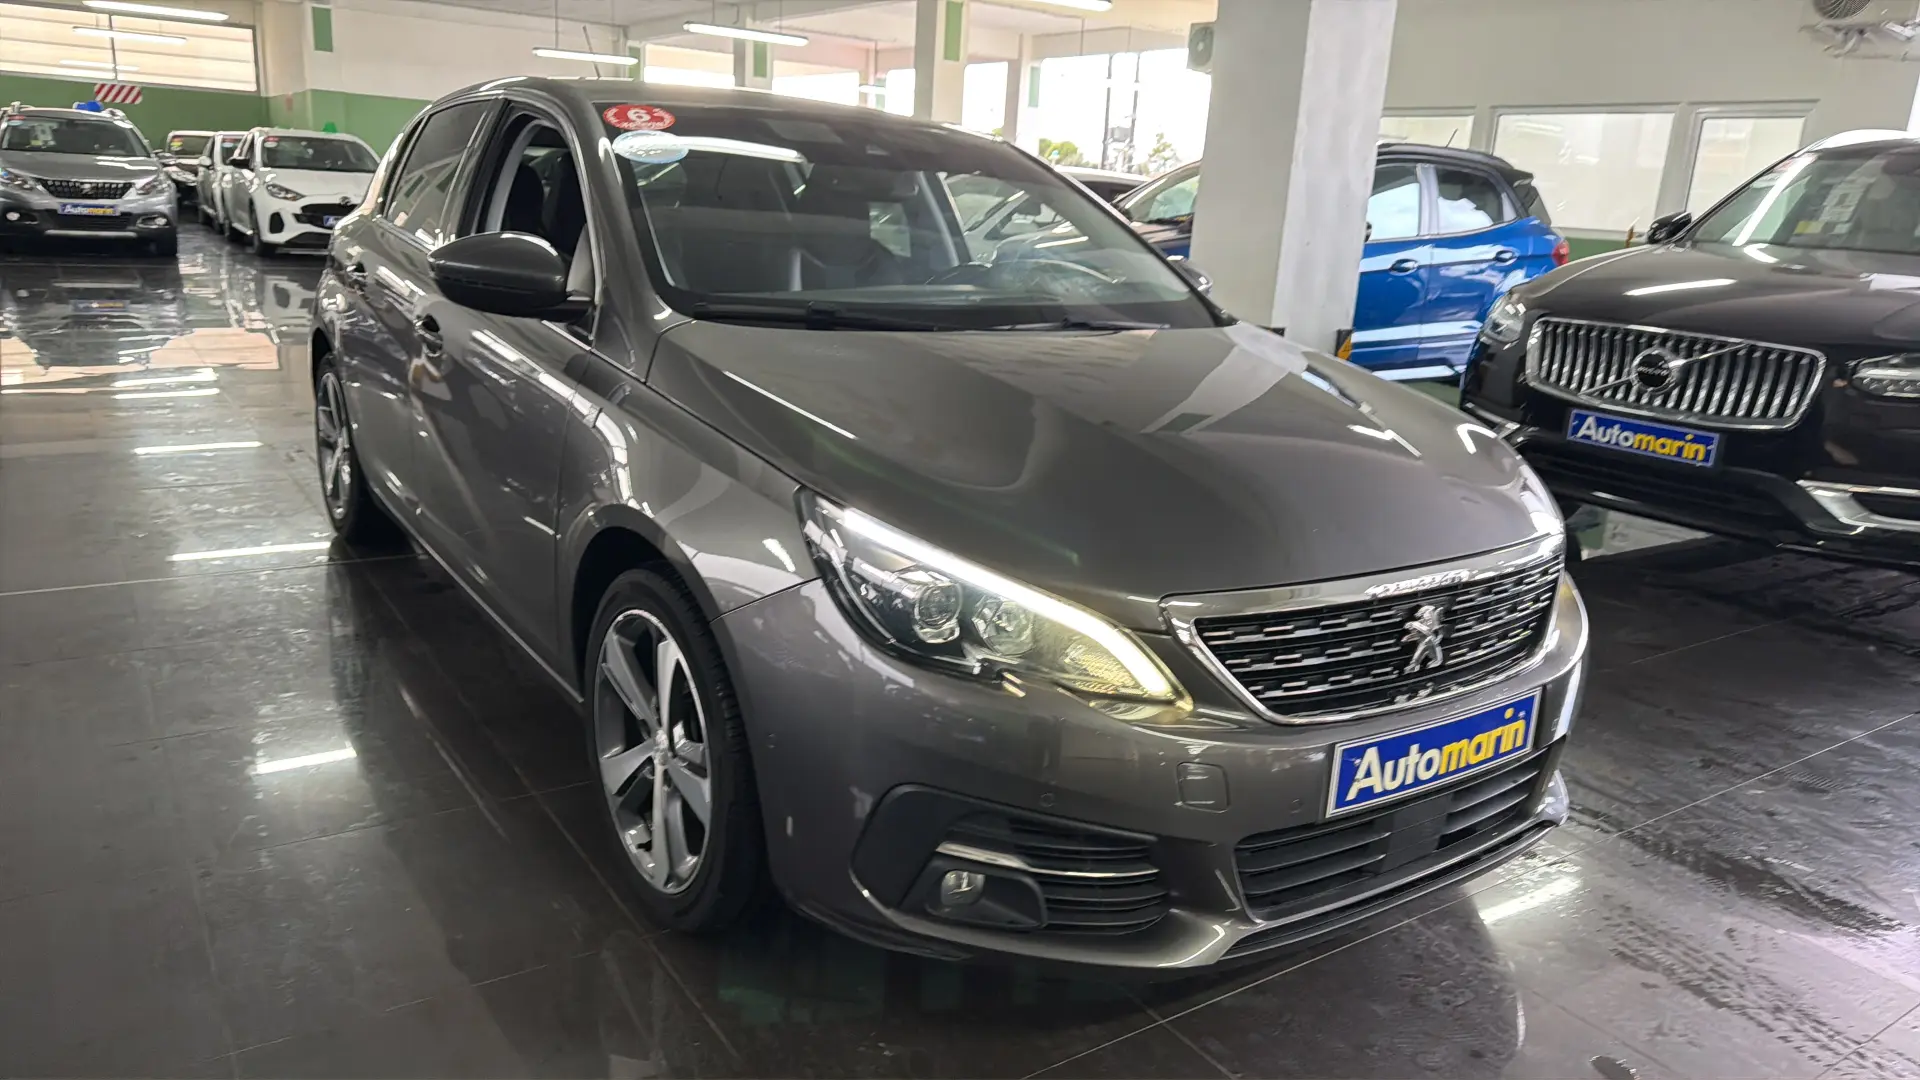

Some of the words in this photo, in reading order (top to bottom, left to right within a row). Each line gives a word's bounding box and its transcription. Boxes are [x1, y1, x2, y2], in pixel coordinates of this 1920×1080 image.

[627, 108, 652, 123] 6
[1575, 415, 1707, 462] Automarin
[1345, 707, 1527, 802] Automarin
